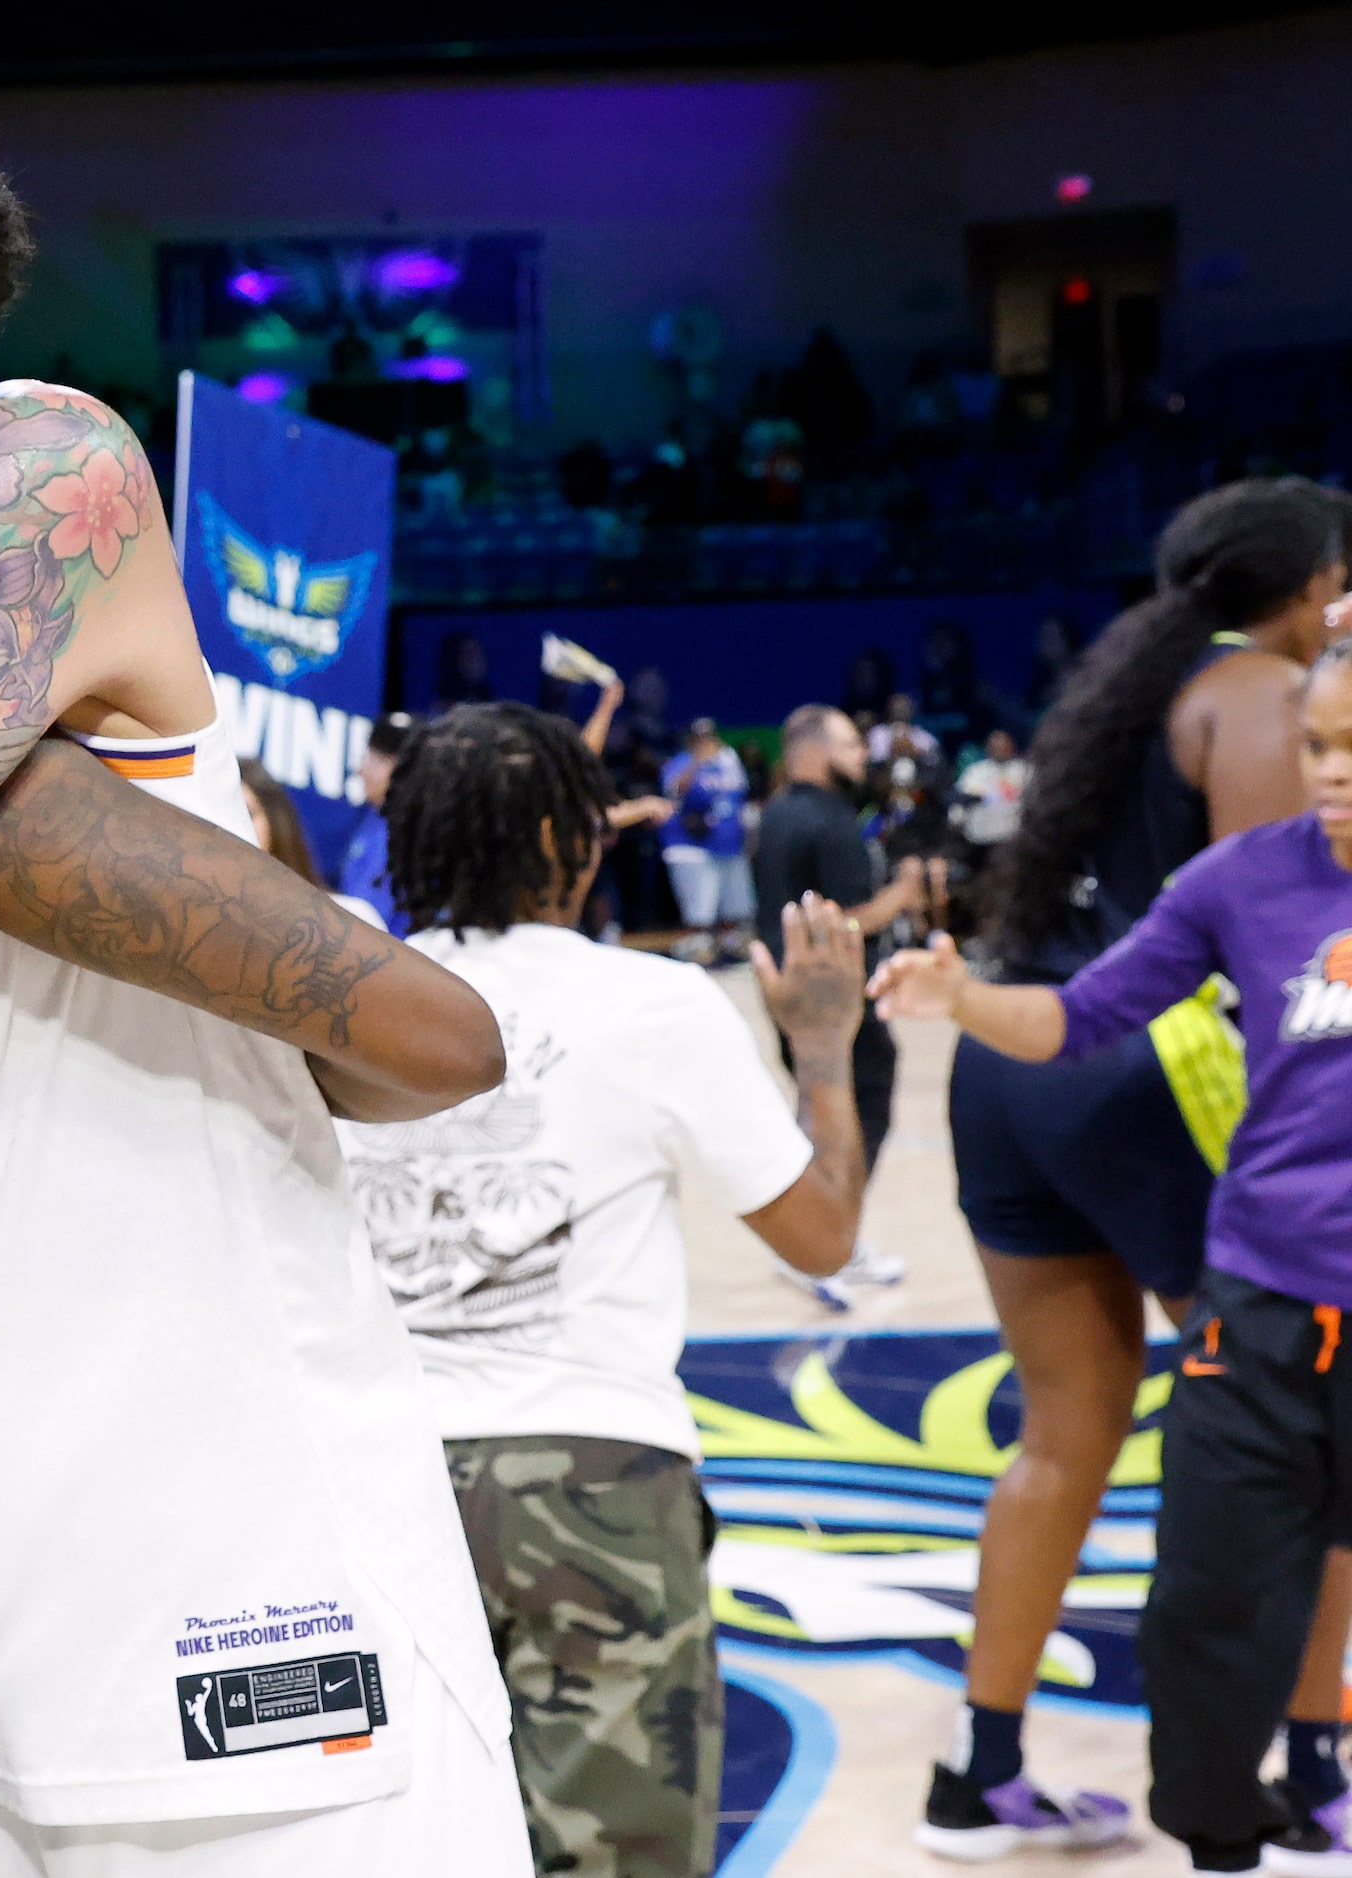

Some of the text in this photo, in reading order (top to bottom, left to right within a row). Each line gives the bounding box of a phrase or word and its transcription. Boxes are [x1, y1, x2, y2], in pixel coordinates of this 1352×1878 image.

[185, 1600, 339, 1632] Phoenix Mercury
[175, 1614, 354, 1657] NIKE HEROINE EDITION
[228, 1693, 247, 1709] 48
